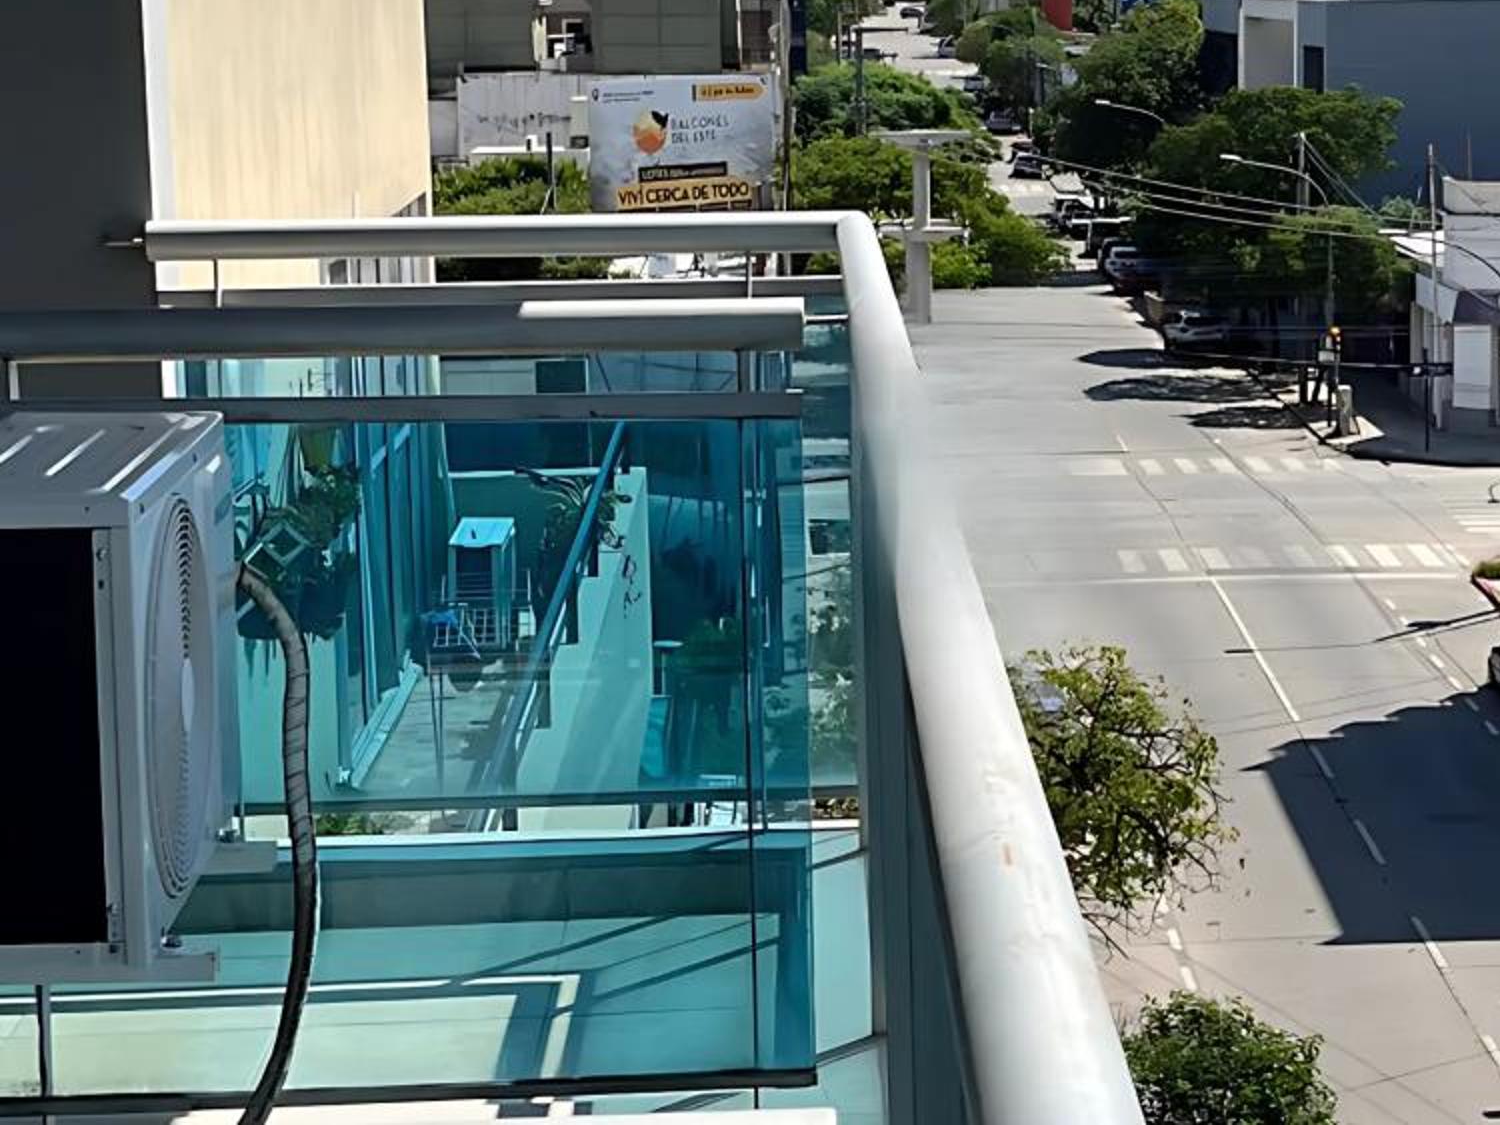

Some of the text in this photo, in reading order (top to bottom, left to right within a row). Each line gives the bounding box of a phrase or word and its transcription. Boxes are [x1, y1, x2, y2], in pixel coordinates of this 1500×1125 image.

[646, 187, 689, 203] CERCA
[692, 186, 708, 200] DE
[712, 182, 749, 198] TODO
